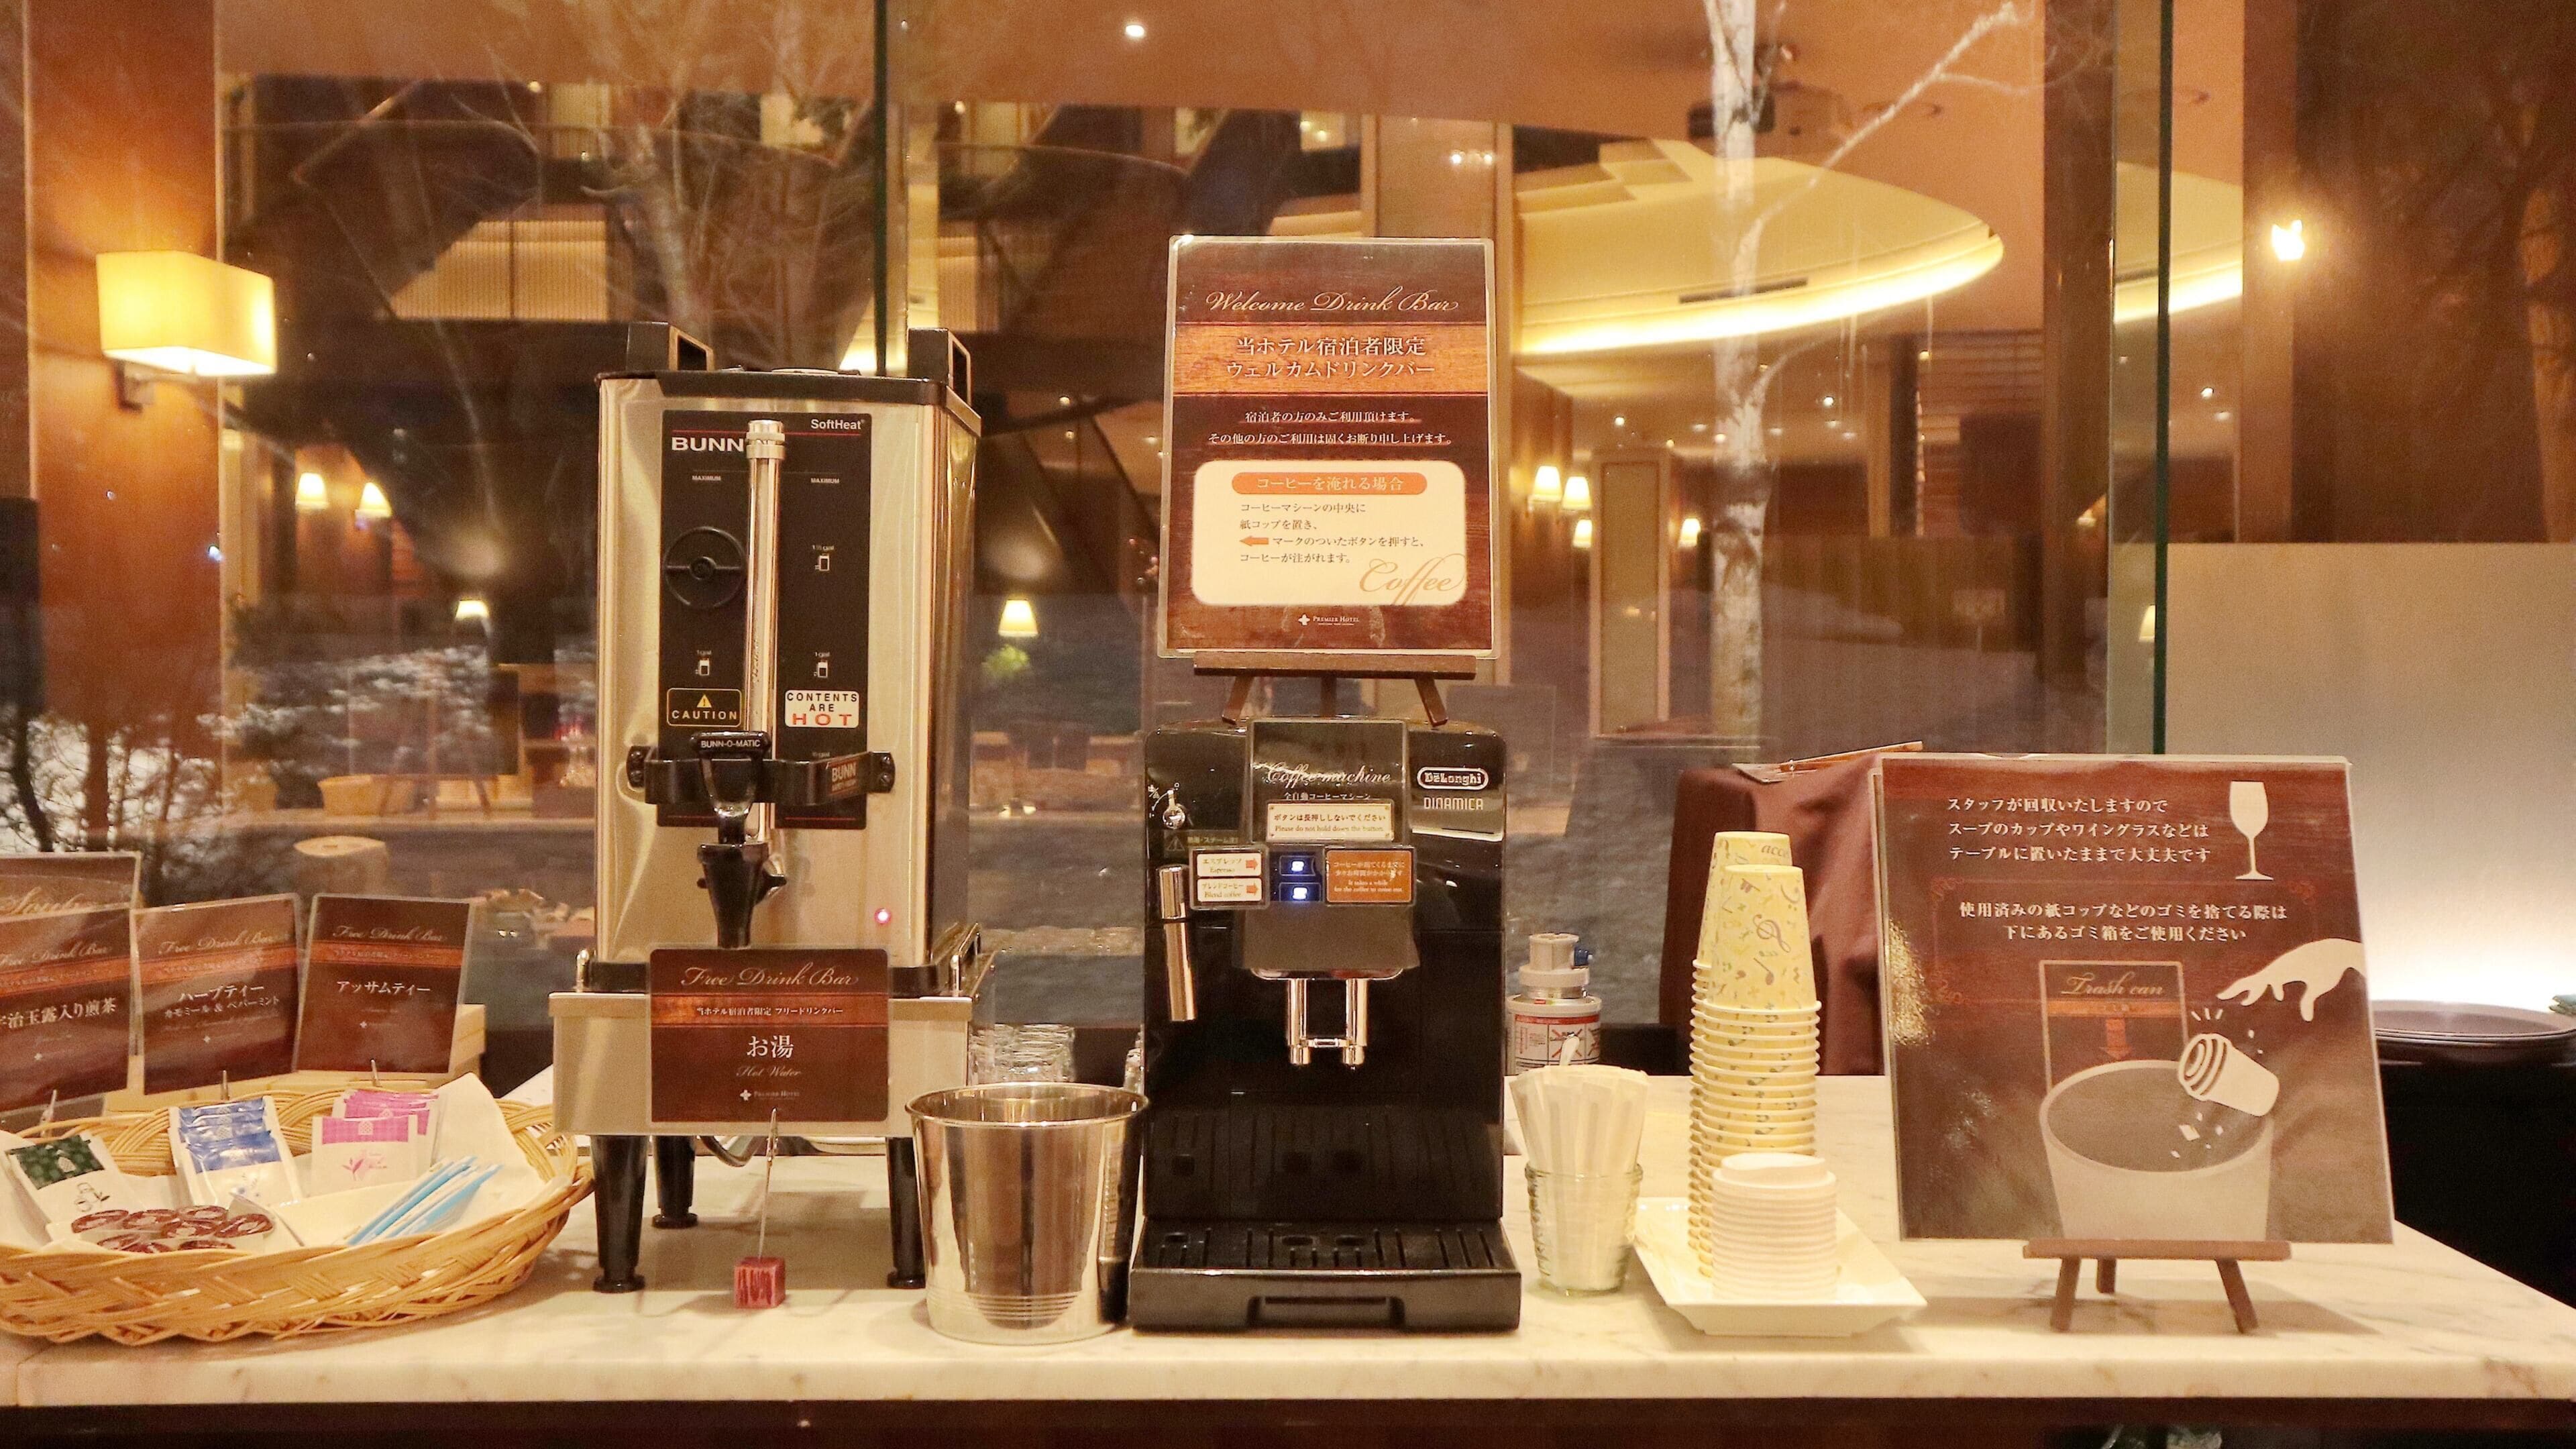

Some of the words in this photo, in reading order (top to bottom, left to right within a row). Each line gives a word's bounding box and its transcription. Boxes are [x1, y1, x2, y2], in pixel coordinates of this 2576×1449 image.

[1205, 291, 1305, 311] Welcome
[1311, 286, 1403, 311] Drink
[1398, 290, 1459, 311] Bar
[1236, 337, 1426, 356] 当ホテル宿泊者限定
[1226, 361, 1435, 378] ウェルカムドリンクバー
[1245, 411, 1415, 423] 宿泊者の方のみご利用頂けます。
[672, 437, 744, 451] BUNN
[1208, 433, 1452, 446] その他の方のご利用は固くお断り申し上げます。
[1257, 476, 1403, 491] コーヒーを淹れる場合
[1240, 502, 1366, 514] コーヒーマシーンの中央に
[1240, 519, 1318, 530] 紙コップを置き、
[1273, 536, 1424, 547] マークのついたボタンを押すと、
[1240, 552, 1351, 564] コーヒーが注がれます。
[1359, 553, 1465, 604] Coffee
[787, 692, 857, 703] CONTENTS
[672, 710, 737, 720] CAUTION
[810, 703, 835, 712] ARE
[792, 714, 852, 726] HOT
[701, 739, 761, 748] BUNN-O-MATIC
[832, 761, 857, 783] BUNN
[1267, 762, 1316, 788] Coffee
[1424, 797, 1484, 810] DINAMICA
[1947, 798, 2167, 813] スタッフが回収いたしますので
[1275, 813, 1385, 822] ボタンは長押ししないでください
[1949, 822, 2209, 838] スープのカップやワイングラスなどは
[1949, 846, 2211, 863] テーブルに置いたままで大丈夫です
[1959, 902, 2287, 920] 使用済みの紙コップなどのゴミを捨てる際は
[2004, 925, 2247, 942] 下にあるゴミ箱をご使用ください
[681, 967, 733, 986] Free
[738, 961, 813, 986] Drink
[809, 965, 859, 986] Bar
[337, 980, 431, 996] アッサムティー
[2061, 971, 2135, 995] Trash
[2129, 985, 2163, 995] can
[746, 1034, 794, 1059] お湯
